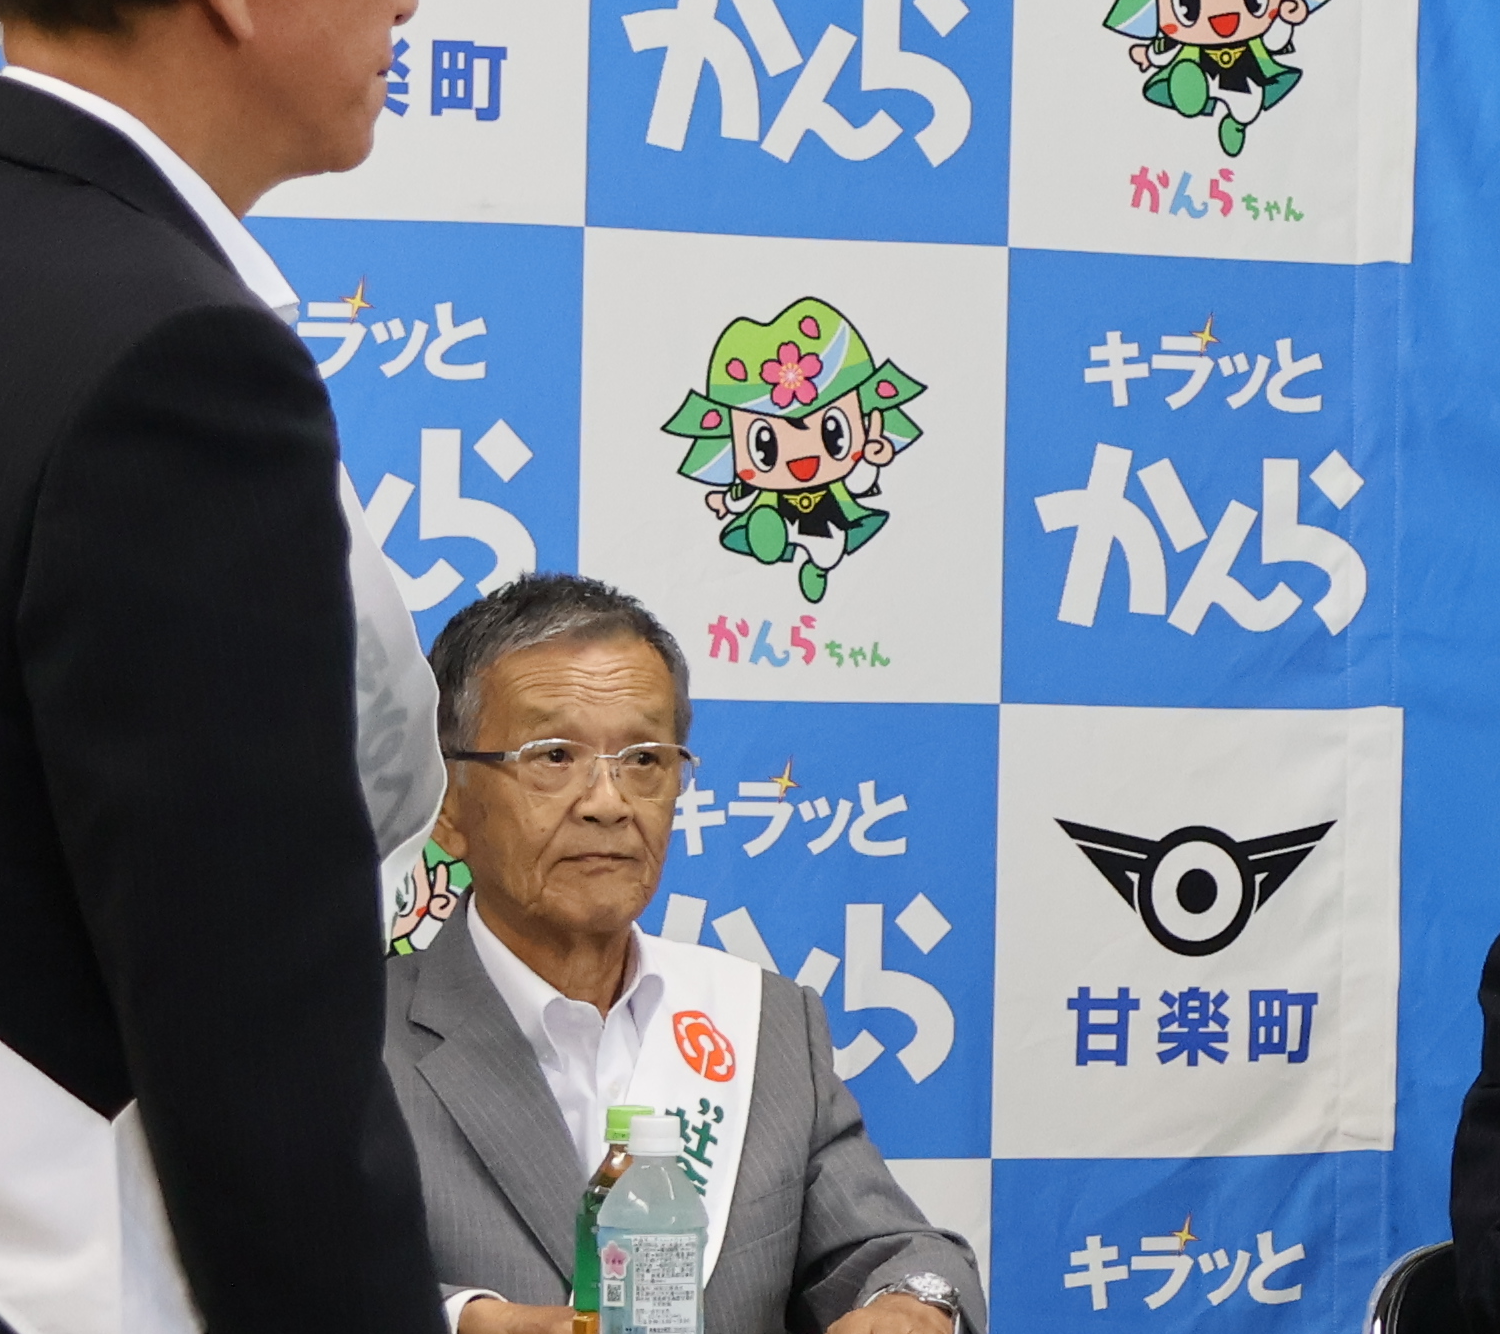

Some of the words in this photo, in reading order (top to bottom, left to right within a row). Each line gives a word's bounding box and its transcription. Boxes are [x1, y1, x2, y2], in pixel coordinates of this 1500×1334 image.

[1131, 167, 1302, 220] かんらちゃん
[297, 301, 488, 381] ラッと
[1085, 331, 1322, 412] キラッと
[1035, 443, 1367, 635] かんら
[709, 615, 888, 667] かんらちゃん
[1068, 987, 1317, 1066] 甘楽町
[1065, 1232, 1305, 1309] キラッと
